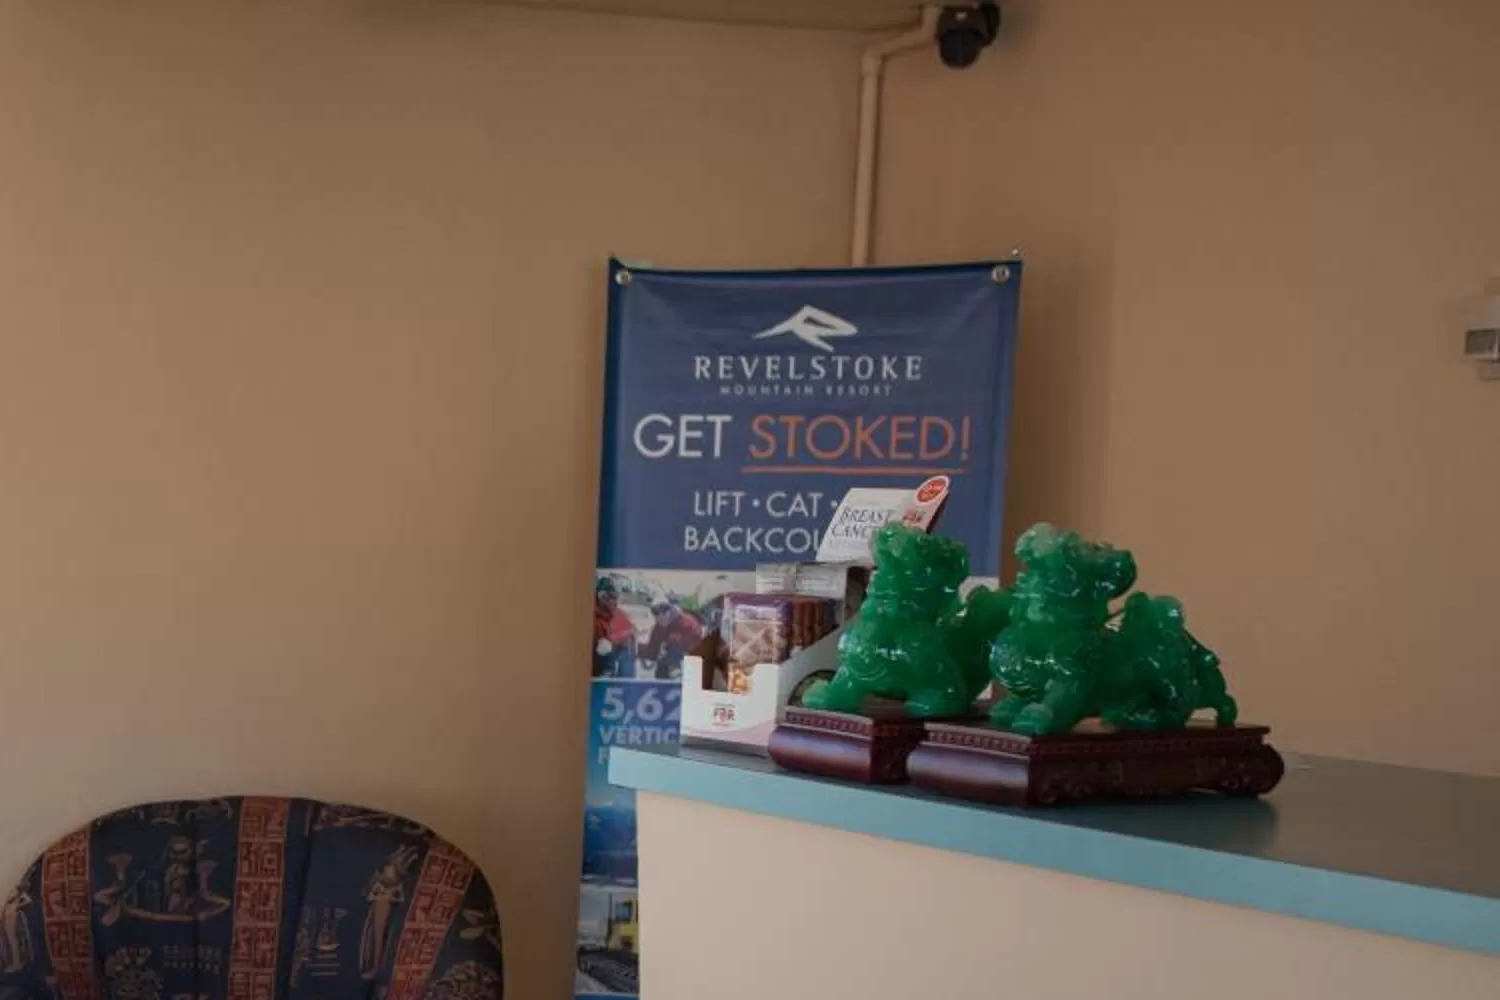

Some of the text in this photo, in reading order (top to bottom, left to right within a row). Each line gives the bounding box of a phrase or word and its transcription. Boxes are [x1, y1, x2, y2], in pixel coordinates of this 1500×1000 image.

[694, 355, 922, 380] REVELSTOKE
[719, 384, 892, 396] MOUNTAIN RESORT
[633, 413, 971, 461] GET STOKED!
[694, 490, 824, 518] LIFT CAT
[839, 506, 897, 528] BREAST
